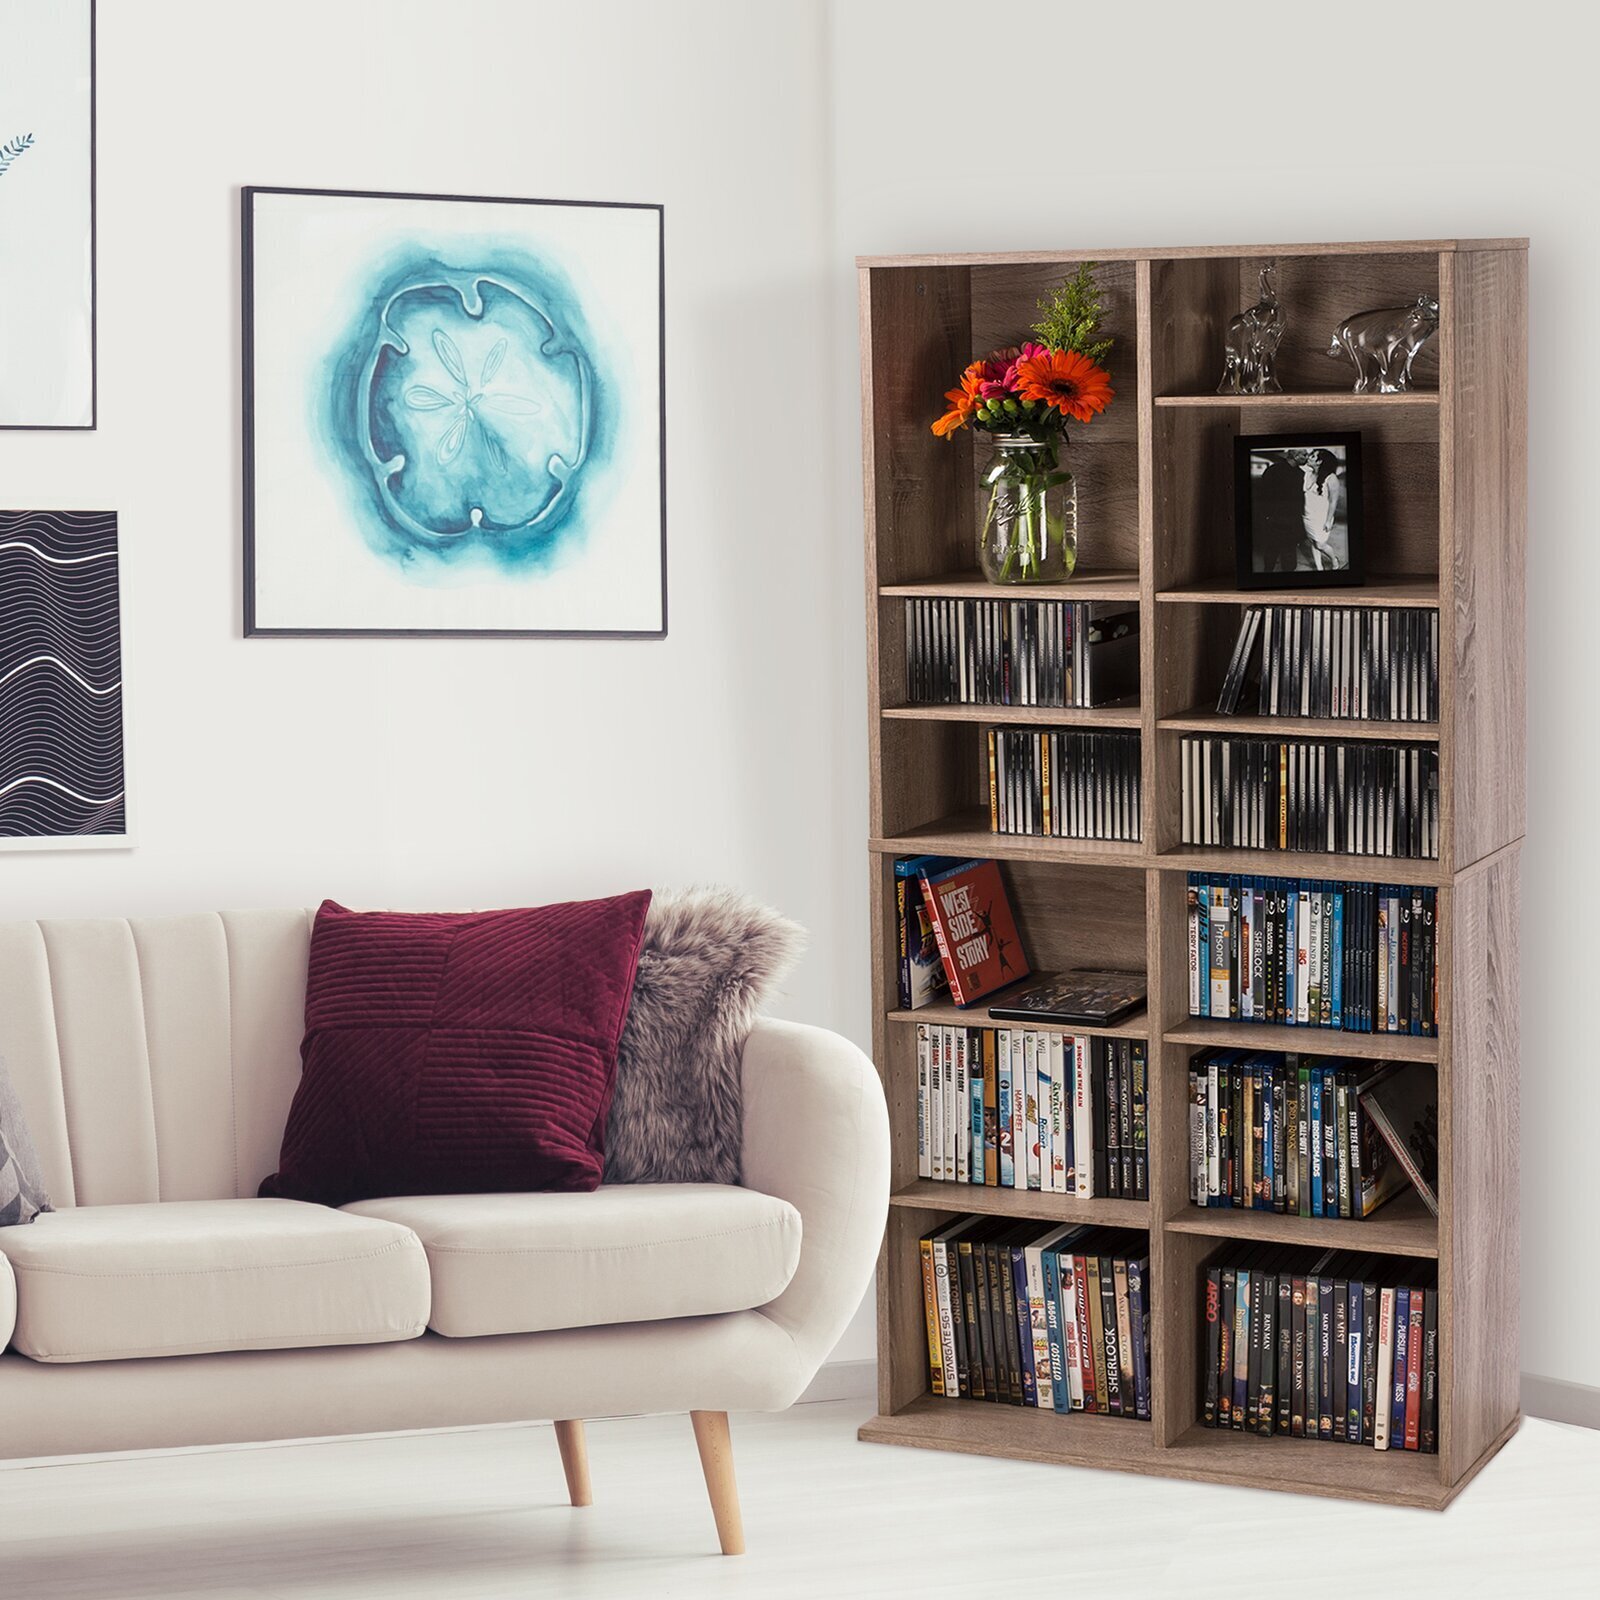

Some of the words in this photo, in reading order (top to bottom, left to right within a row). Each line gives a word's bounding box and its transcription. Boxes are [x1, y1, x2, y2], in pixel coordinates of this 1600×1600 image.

[940, 885, 970, 918] WEST
[948, 910, 978, 942] SIDE
[956, 935, 990, 970] STORY
[1214, 924, 1225, 967] Prisoner
[1254, 931, 1262, 978] SHERLOCK
[1299, 949, 1307, 965] BIG
[1038, 1038, 1046, 1054] Wii
[1052, 1082, 1060, 1107] SANTA
[1288, 1100, 1297, 1119] LORD
[1349, 1111, 1357, 1128] STAR
[1001, 1131, 1011, 1146] 2
[1039, 1118, 1047, 1149] Resort
[1109, 1113, 1117, 1146] LEADER
[1288, 1125, 1296, 1150] RINGS
[1299, 1121, 1307, 1134] CALL
[1350, 1129, 1358, 1144] TREK
[1350, 1145, 1359, 1168] BEYOND
[1338, 1149, 1347, 1199] SUPREMACY
[948, 1252, 956, 1281] GRAN
[976, 1261, 984, 1285] STAR
[989, 1261, 997, 1286] STAR
[1002, 1264, 1011, 1289] STAR
[951, 1285, 961, 1324] TORINO
[978, 1286, 986, 1311] WARS
[992, 1287, 1000, 1312] WARS
[1004, 1290, 1012, 1315] WARS
[1206, 1280, 1217, 1323] ARGO
[1047, 1300, 1057, 1329] ABBOTT
[1077, 1278, 1090, 1368] SPIDER-MAN
[1236, 1308, 1245, 1339] Bambi
[1336, 1321, 1345, 1344] MIST
[1381, 1315, 1389, 1345] ACADEMY
[1395, 1325, 1406, 1355] PURSUIT
[943, 1331, 955, 1380] STARGATE
[1051, 1343, 1062, 1381] COSTELLO
[1105, 1328, 1118, 1393] SHERLOCK
[1097, 1366, 1106, 1392] SOUND
